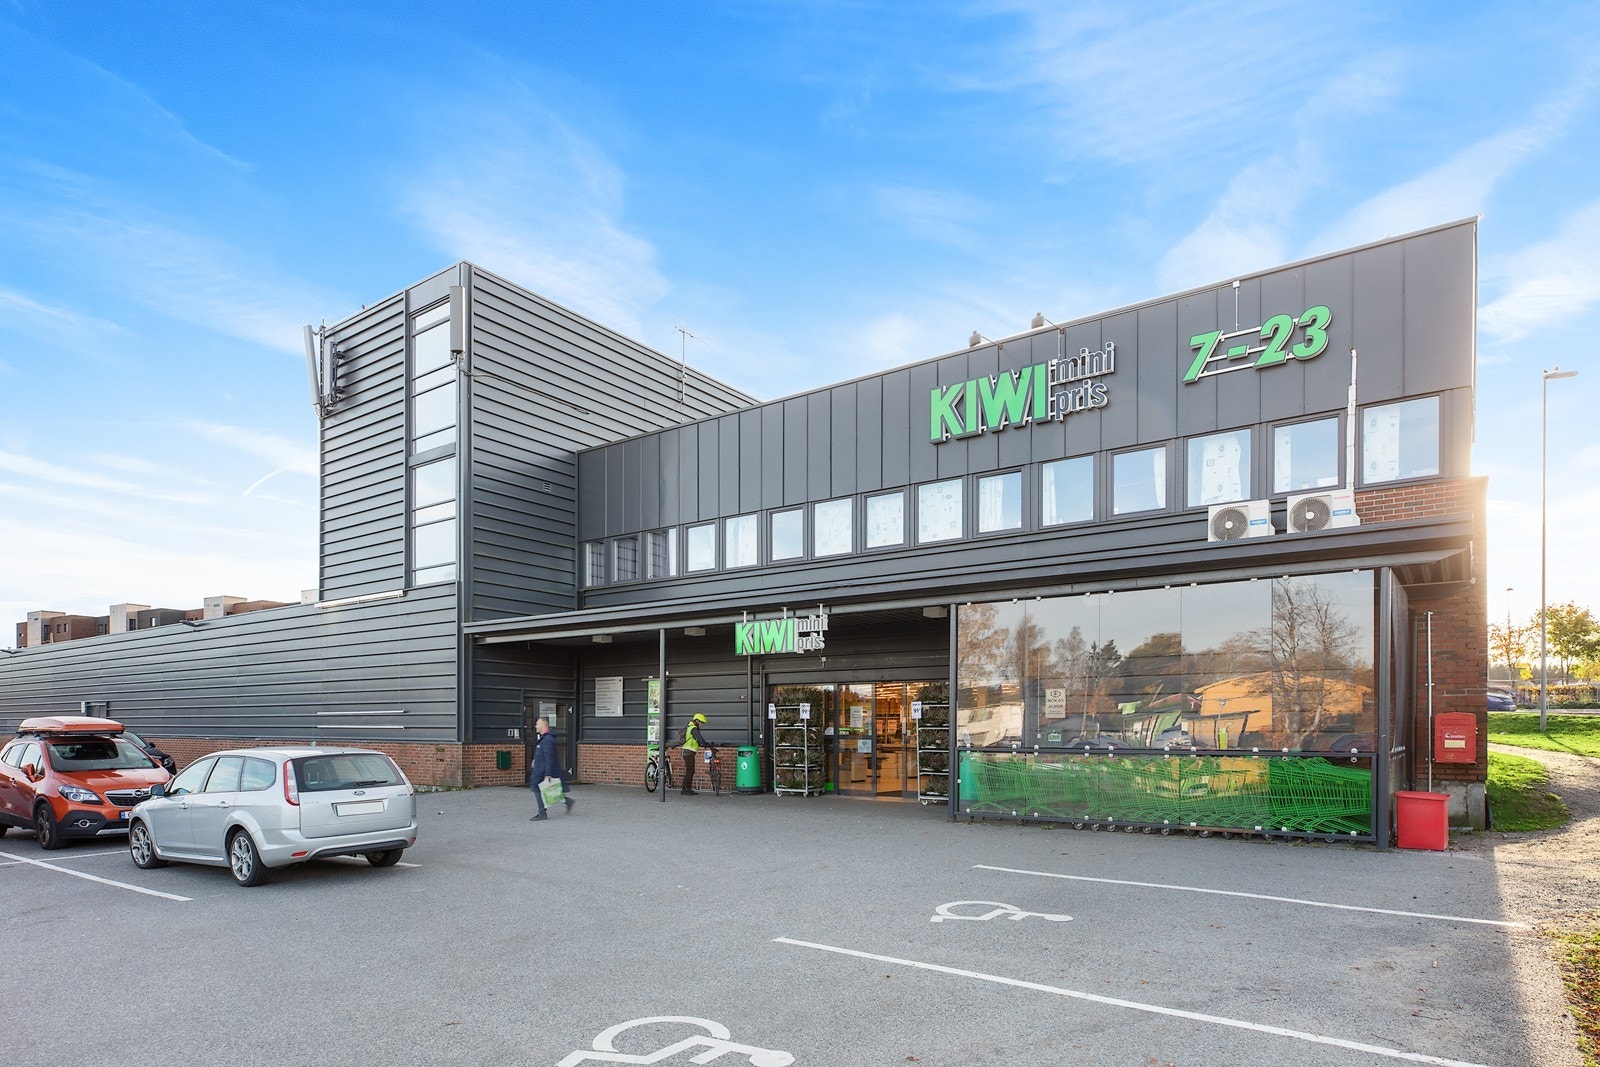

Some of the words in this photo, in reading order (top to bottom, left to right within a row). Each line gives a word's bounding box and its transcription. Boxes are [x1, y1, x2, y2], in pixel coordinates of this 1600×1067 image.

[929, 361, 1049, 443] KIWI
[1054, 341, 1115, 382] mini
[1054, 378, 1109, 421] pris
[735, 618, 795, 655] KIWI
[796, 613, 829, 632] mini
[796, 632, 826, 654] pris
